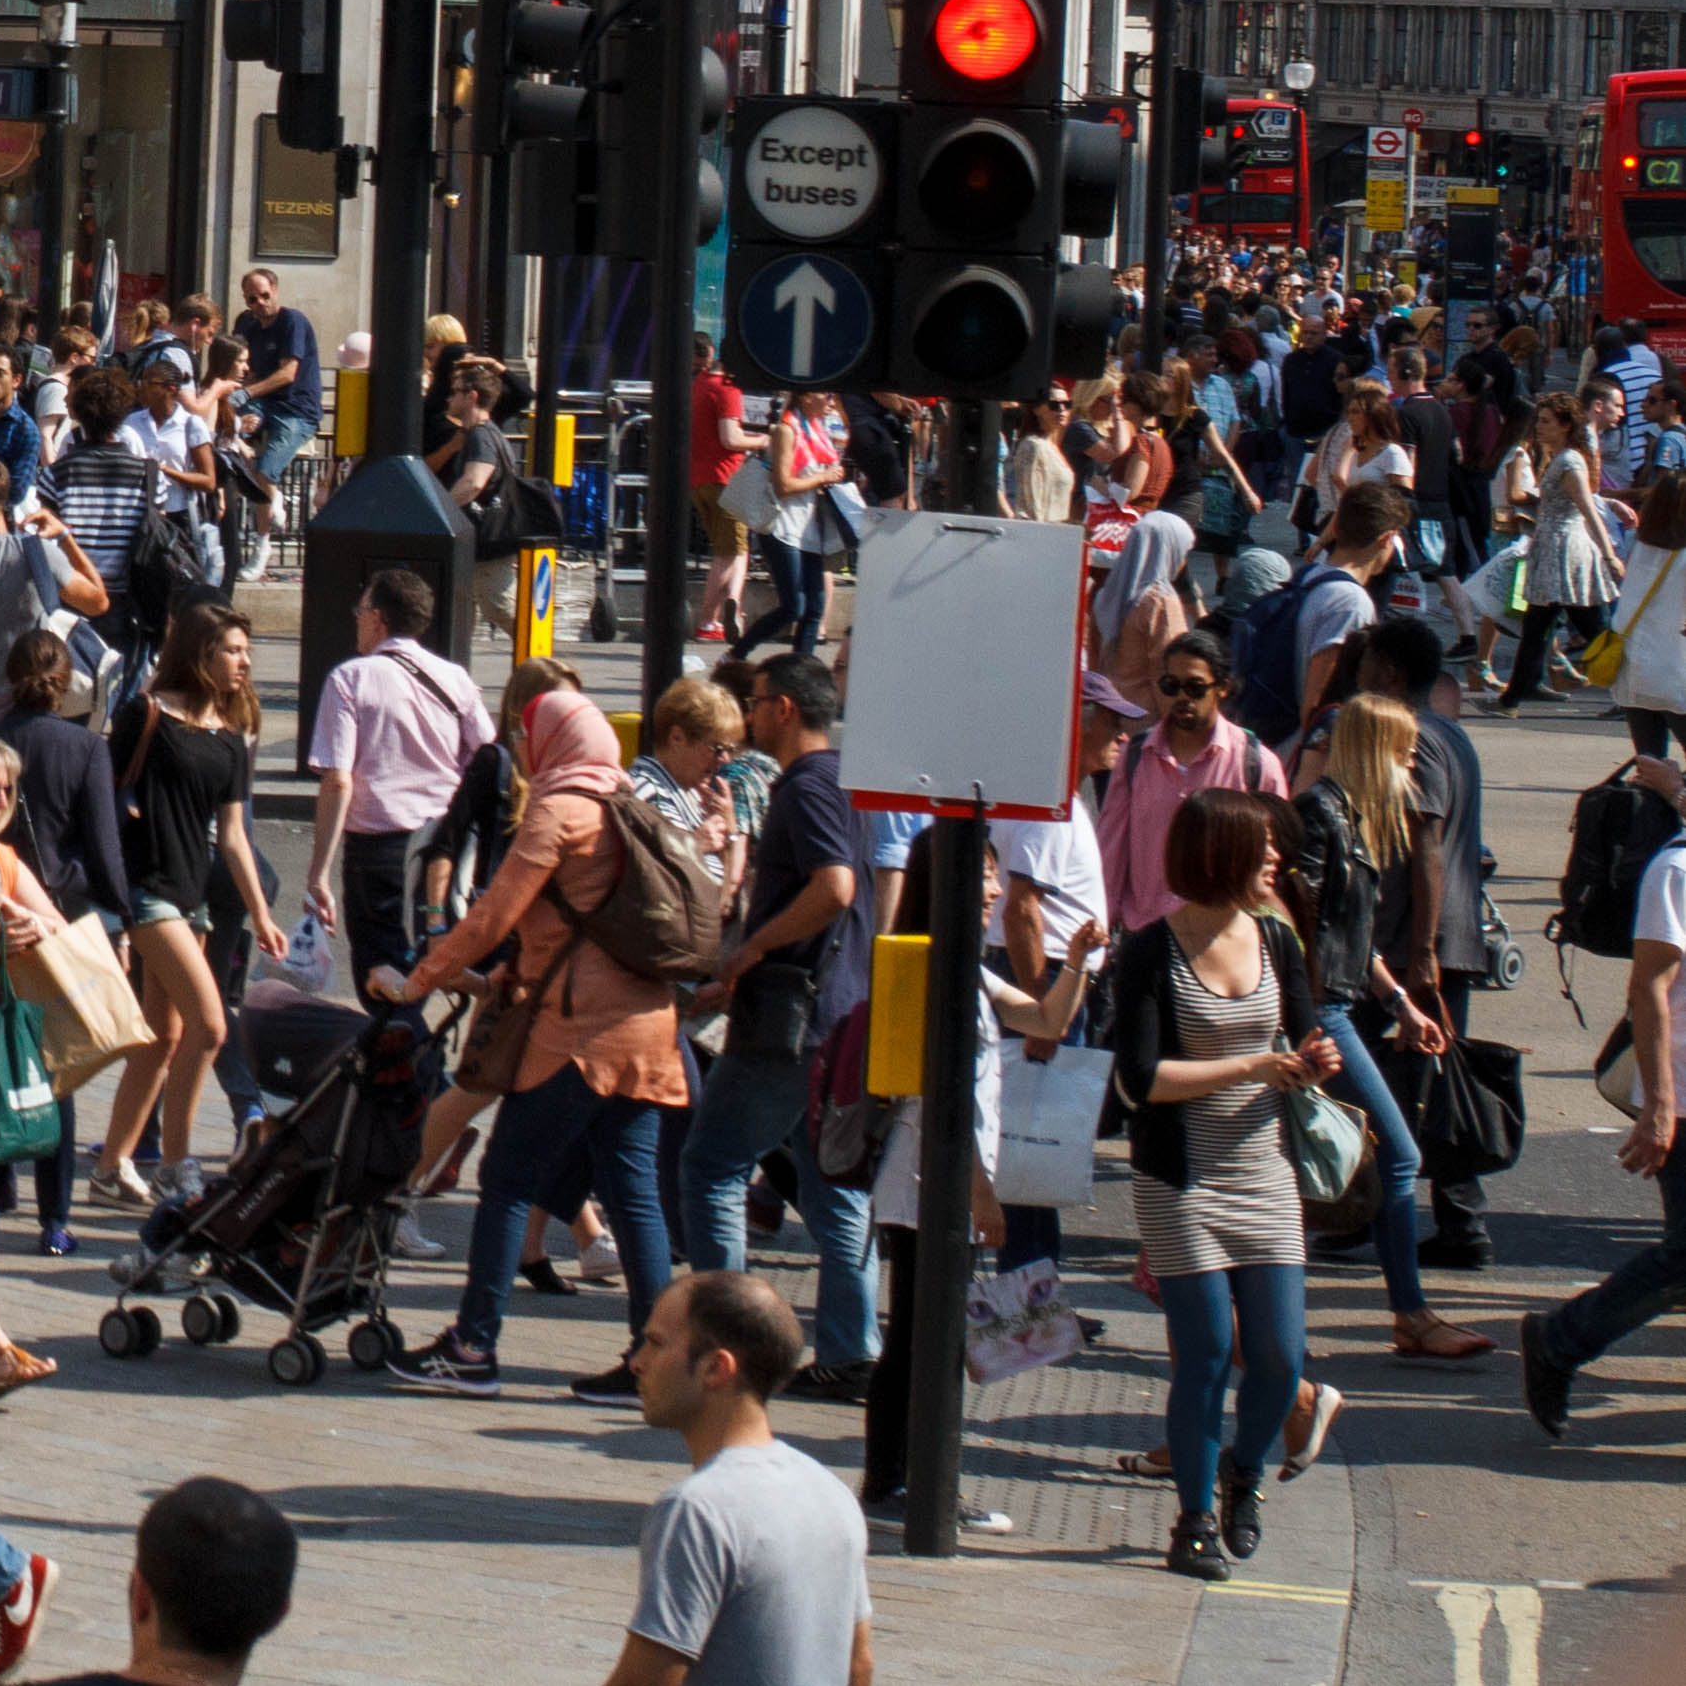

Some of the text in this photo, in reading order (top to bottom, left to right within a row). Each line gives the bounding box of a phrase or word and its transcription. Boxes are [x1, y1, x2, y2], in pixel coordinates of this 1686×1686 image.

[1404, 113, 1421, 123] RG
[760, 137, 868, 172] Except
[1647, 159, 1681, 185] C2
[765, 177, 857, 207] buses
